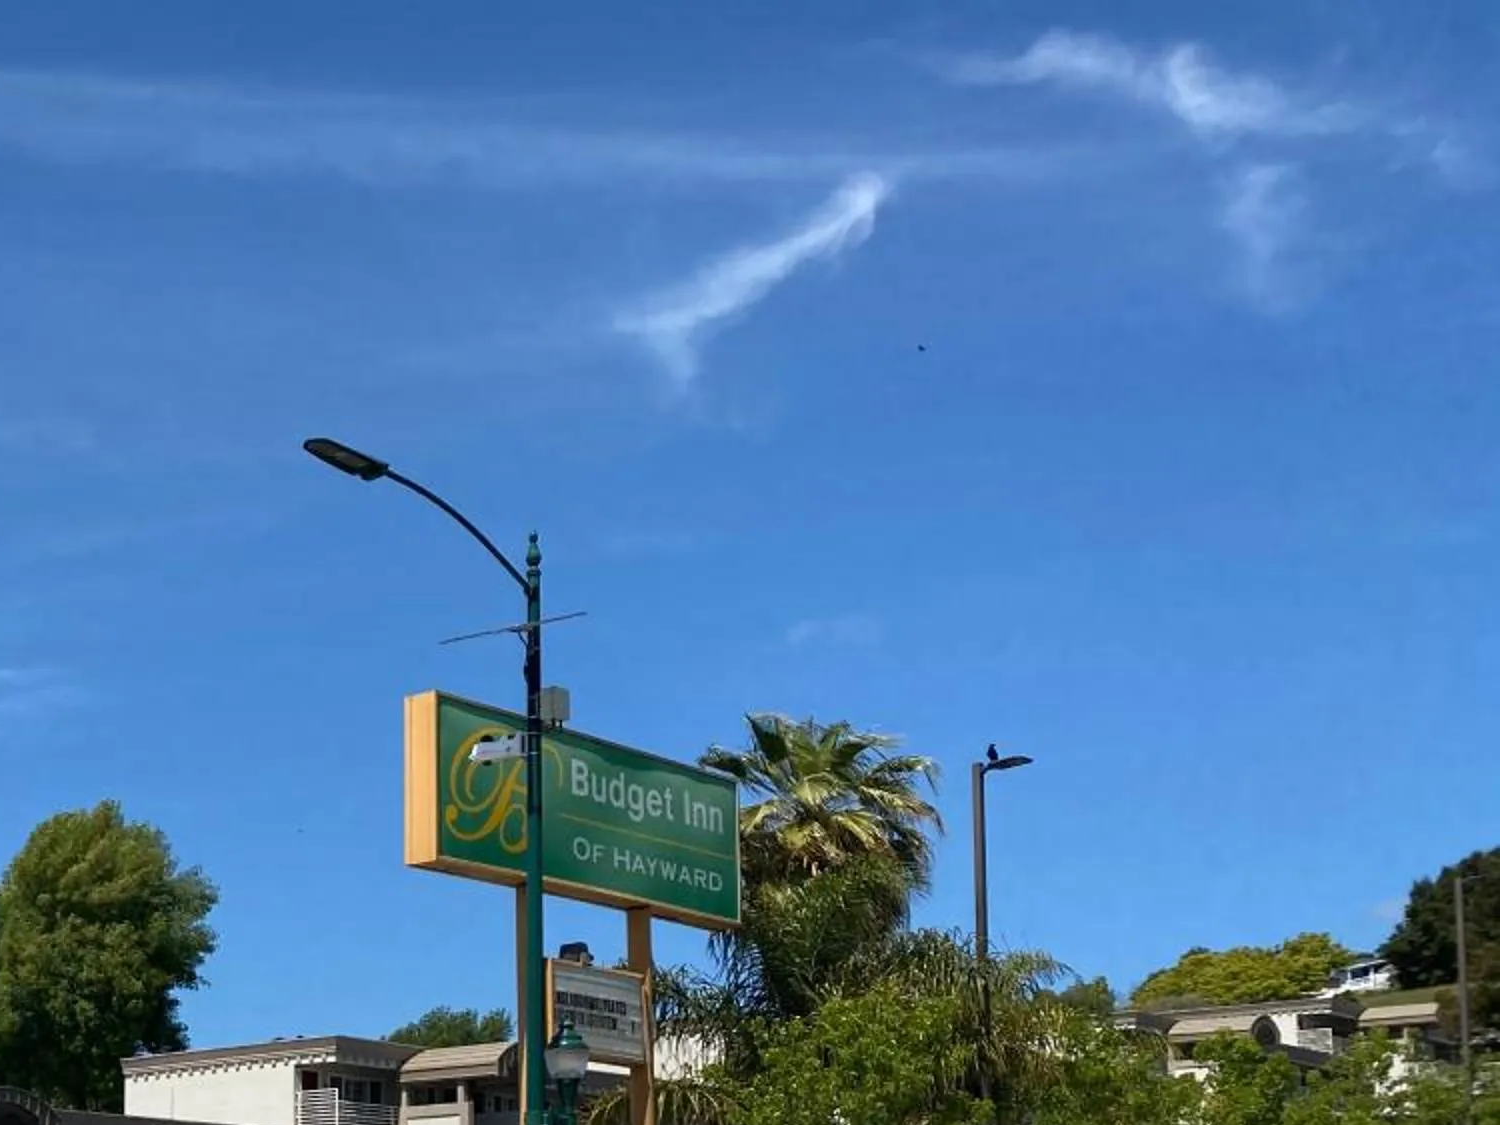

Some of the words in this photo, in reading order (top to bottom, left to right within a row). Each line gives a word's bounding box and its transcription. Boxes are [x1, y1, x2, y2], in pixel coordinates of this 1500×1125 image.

[570, 757, 674, 822] Budget
[683, 789, 724, 834] Inn
[572, 836, 605, 863] OF
[613, 847, 723, 892] HAYWARD
